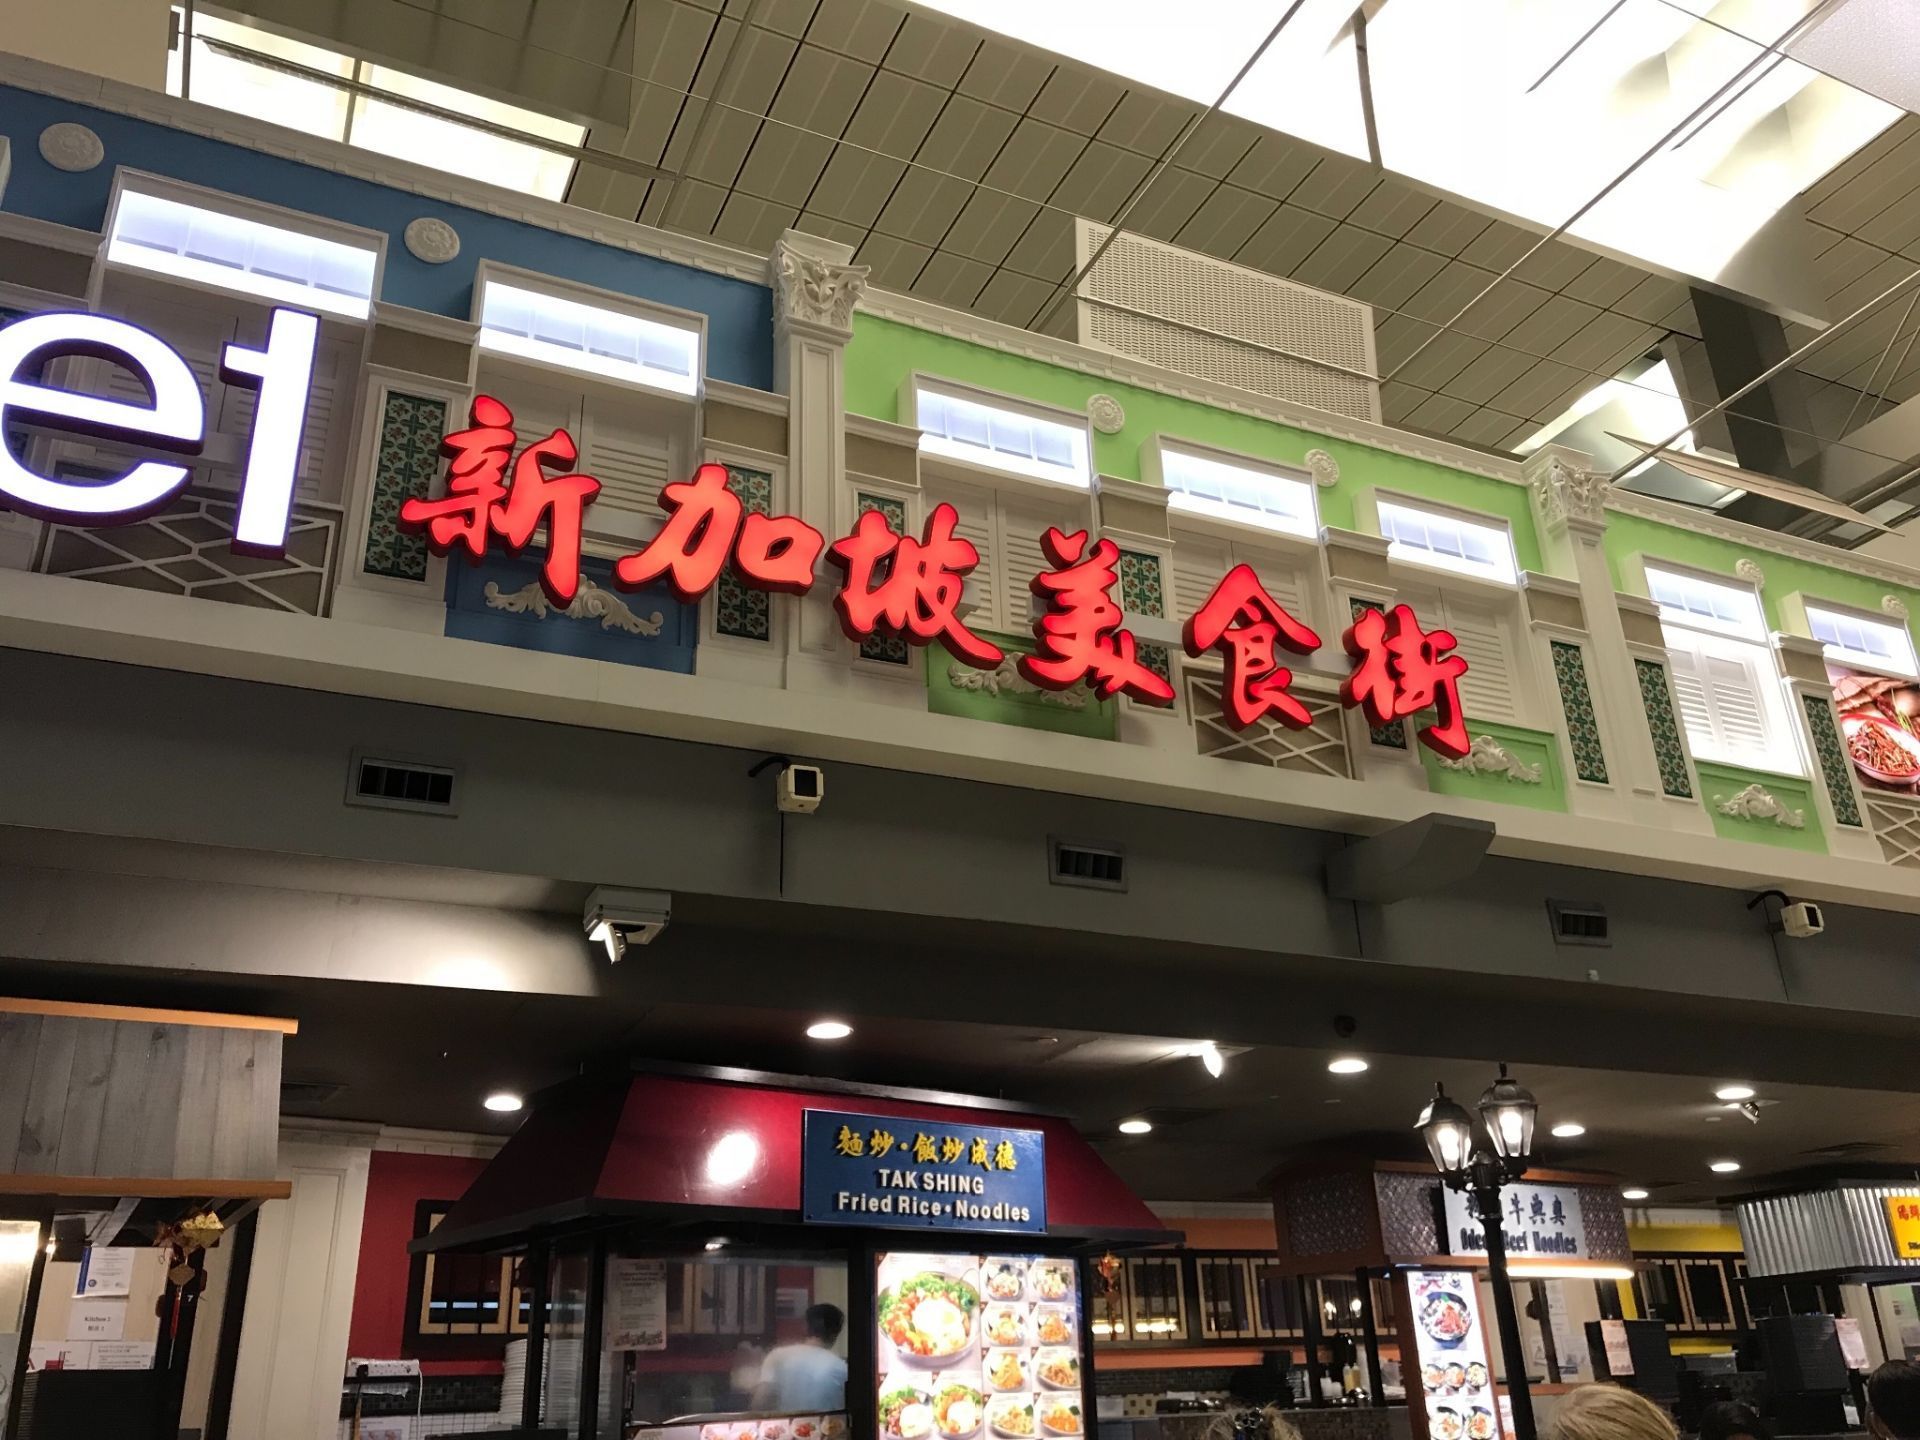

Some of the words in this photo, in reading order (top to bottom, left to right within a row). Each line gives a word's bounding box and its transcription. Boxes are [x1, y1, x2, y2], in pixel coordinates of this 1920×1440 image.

[401, 395, 1471, 760] 新加坡美食街
[878, 1168, 918, 1189] TAK
[923, 1172, 985, 1195] SHING
[838, 1191, 892, 1213] Fried
